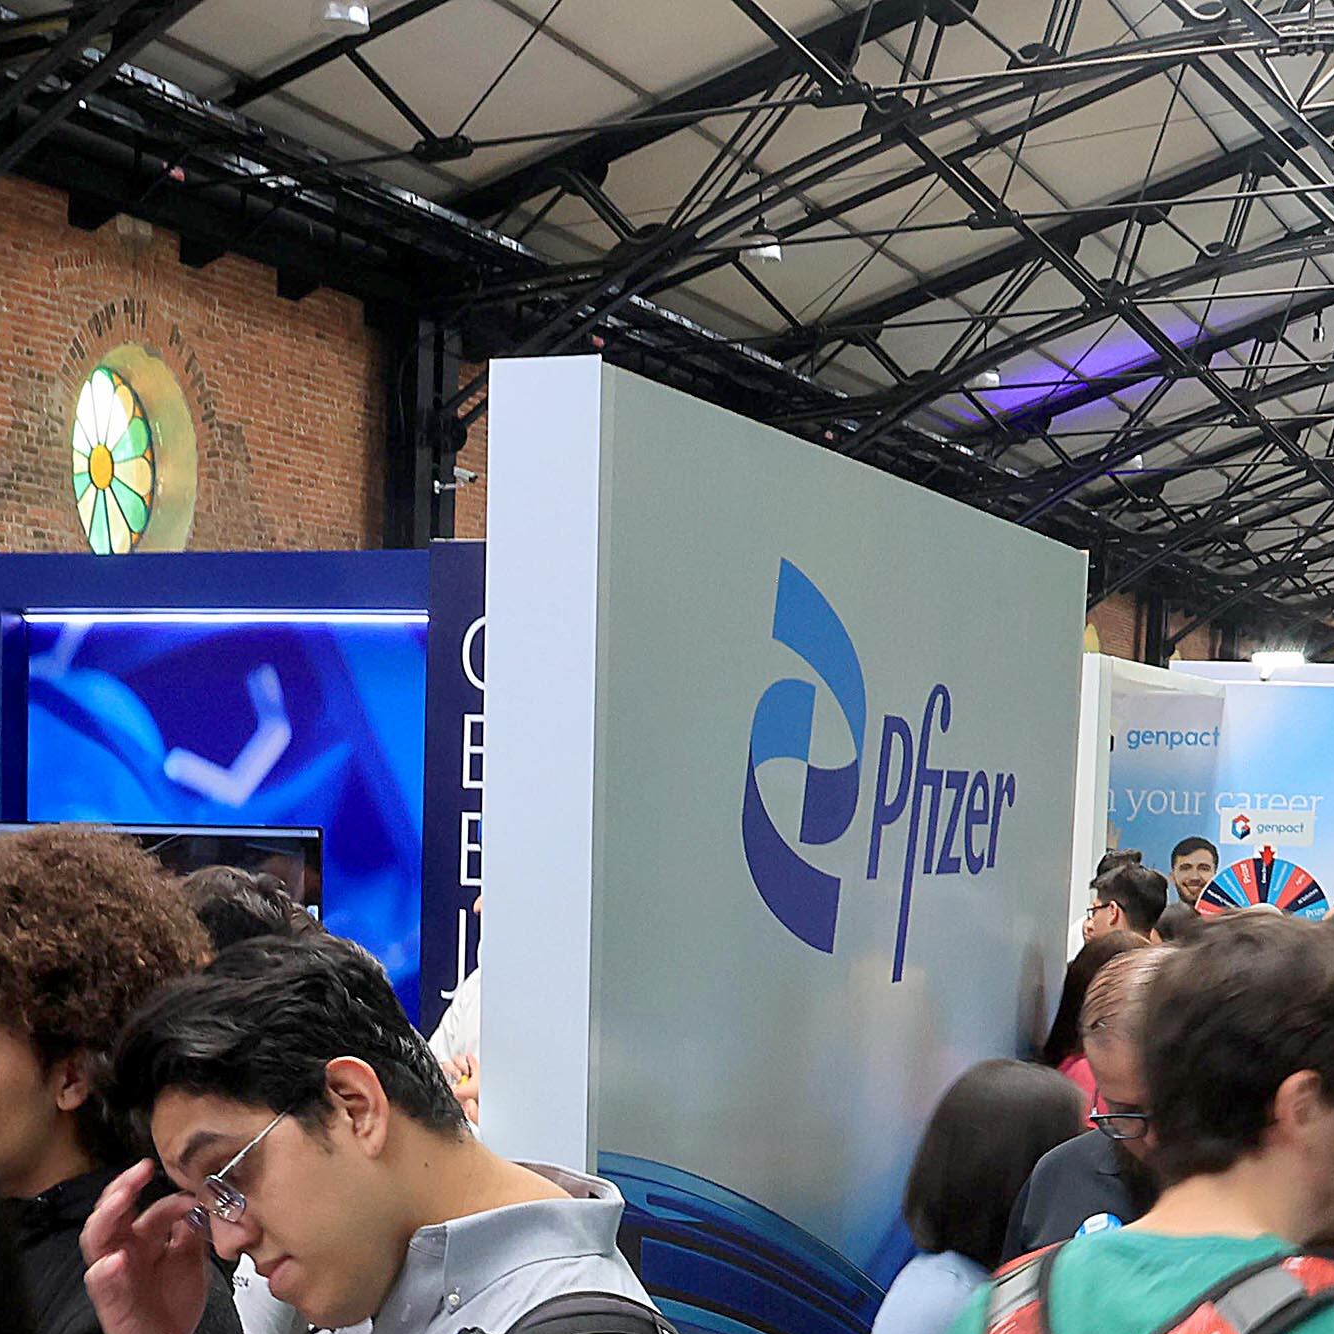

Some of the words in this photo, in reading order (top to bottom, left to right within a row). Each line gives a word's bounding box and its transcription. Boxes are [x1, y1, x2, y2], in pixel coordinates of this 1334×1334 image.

[1127, 726, 1220, 749] genpact
[1125, 788, 1206, 821] your
[1215, 791, 1324, 817] career
[867, 683, 1016, 983] Pfizer
[1256, 822, 1305, 835] genpact
